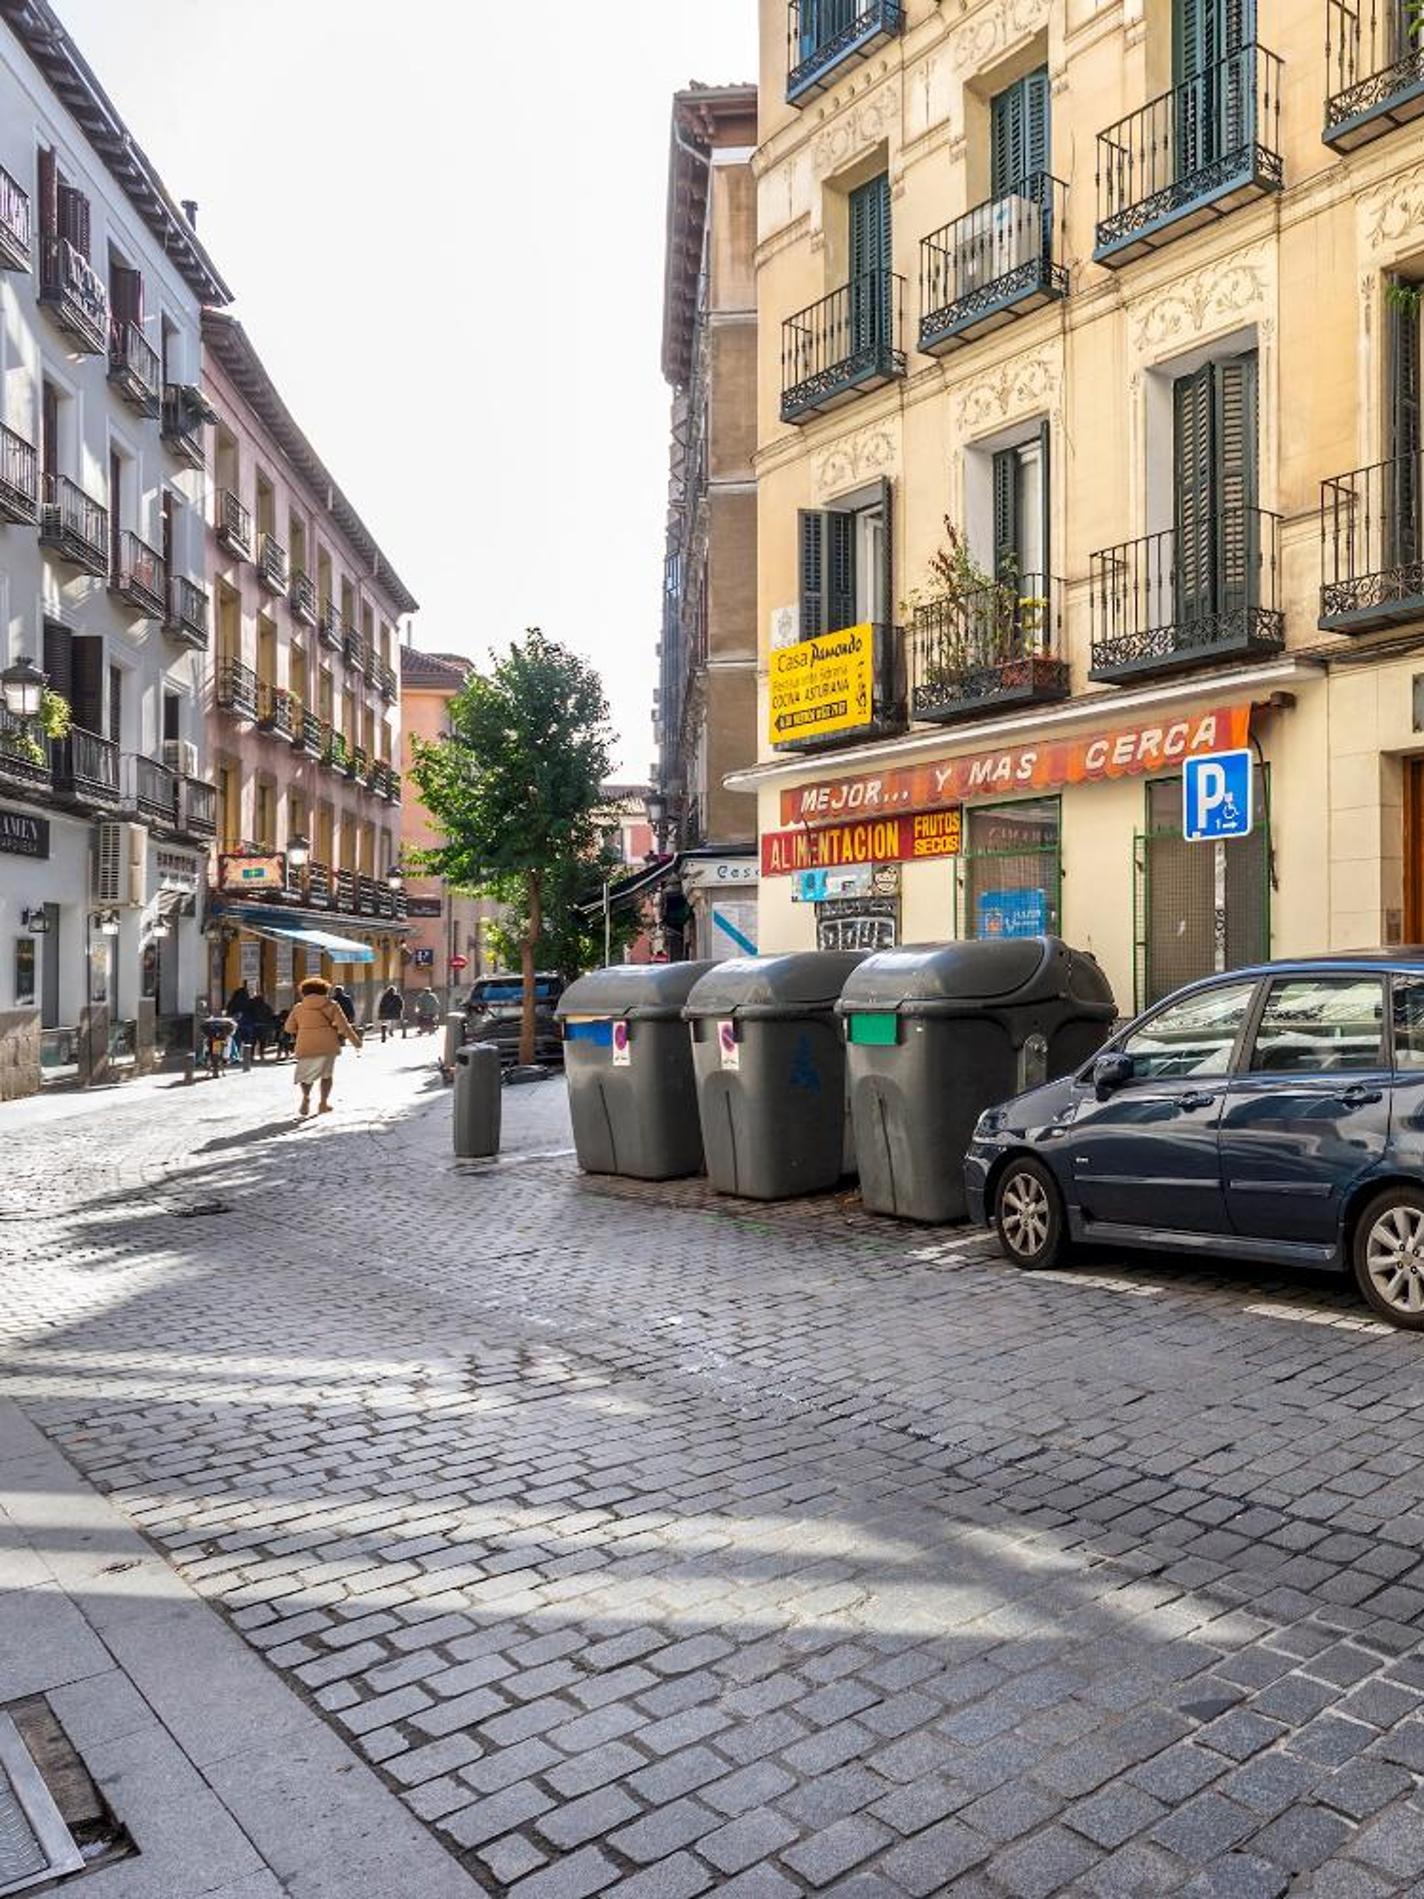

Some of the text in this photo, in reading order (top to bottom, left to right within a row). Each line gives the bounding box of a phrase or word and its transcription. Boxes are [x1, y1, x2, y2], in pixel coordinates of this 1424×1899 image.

[778, 652, 808, 673] Casa
[935, 767, 953, 792] Y
[968, 751, 1038, 786] MAS
[1085, 715, 1217, 770] CERCA
[1197, 763, 1226, 829] P
[914, 812, 960, 838] FRUTOS
[770, 820, 900, 870] ALIMENTACION
[914, 836, 959, 855] SECOS
